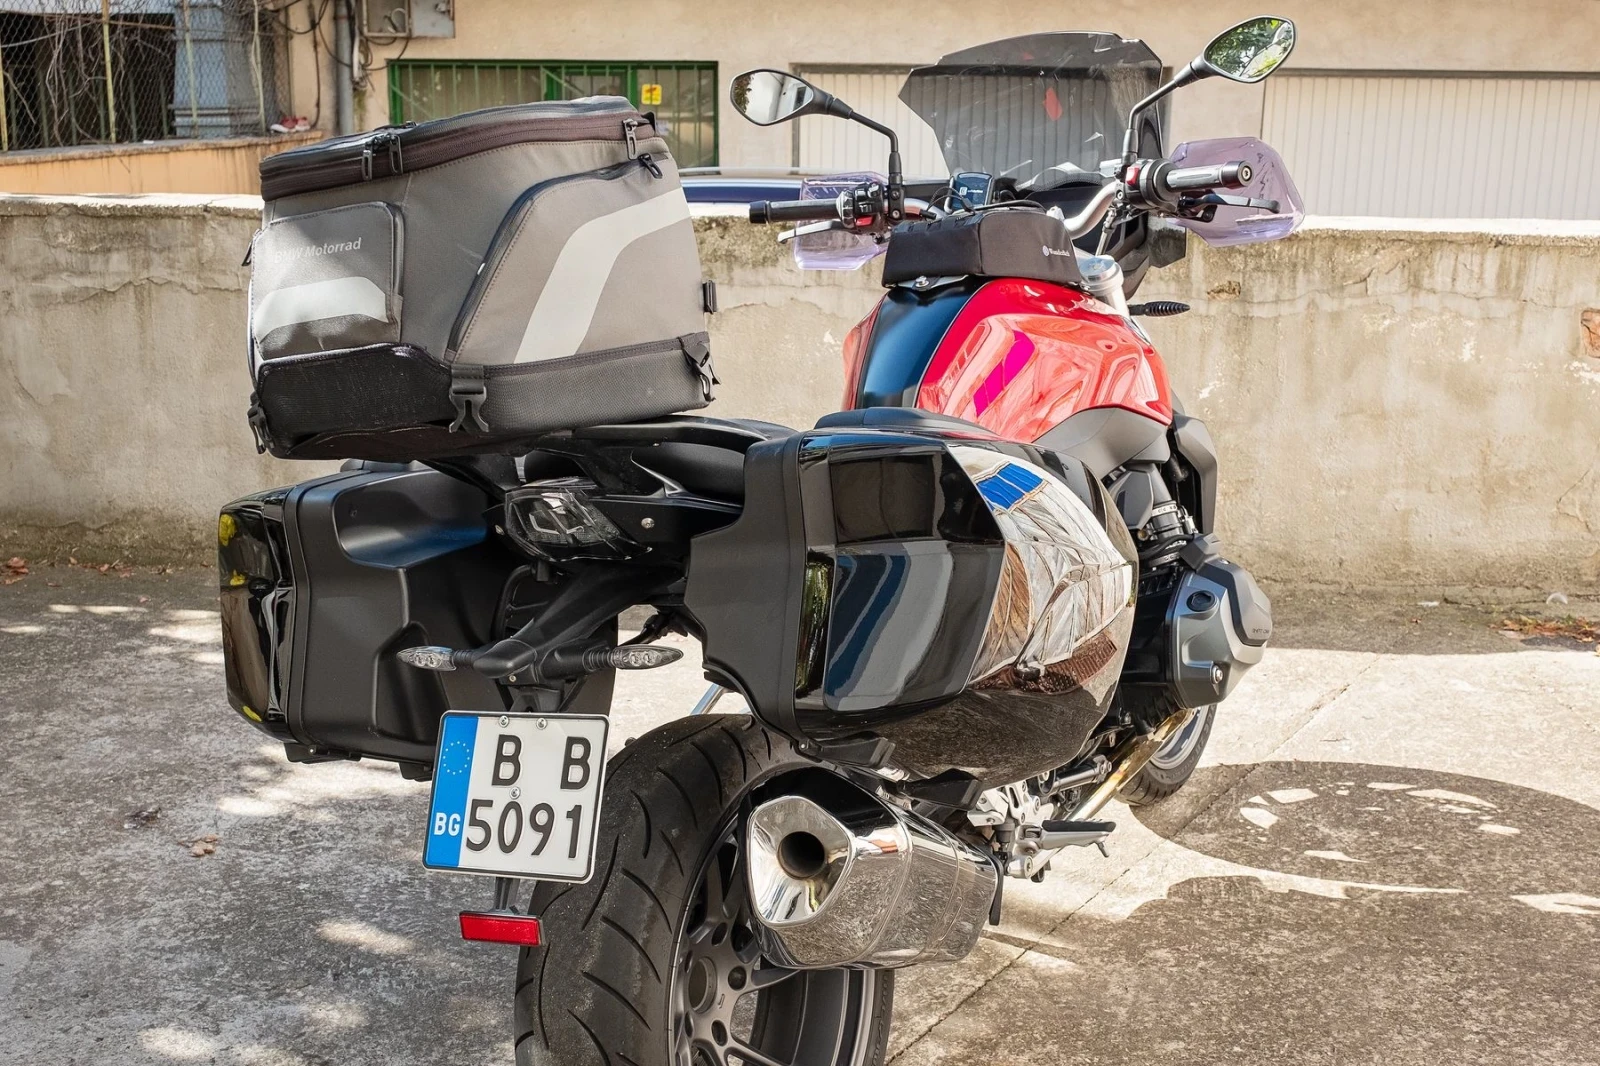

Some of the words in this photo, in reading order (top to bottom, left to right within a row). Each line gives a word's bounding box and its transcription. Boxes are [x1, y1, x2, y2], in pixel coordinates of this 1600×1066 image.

[304, 236, 362, 257] Motorrad
[491, 734, 522, 786] B
[560, 736, 592, 790] B
[433, 812, 461, 837] BG
[465, 798, 582, 859] 5091
